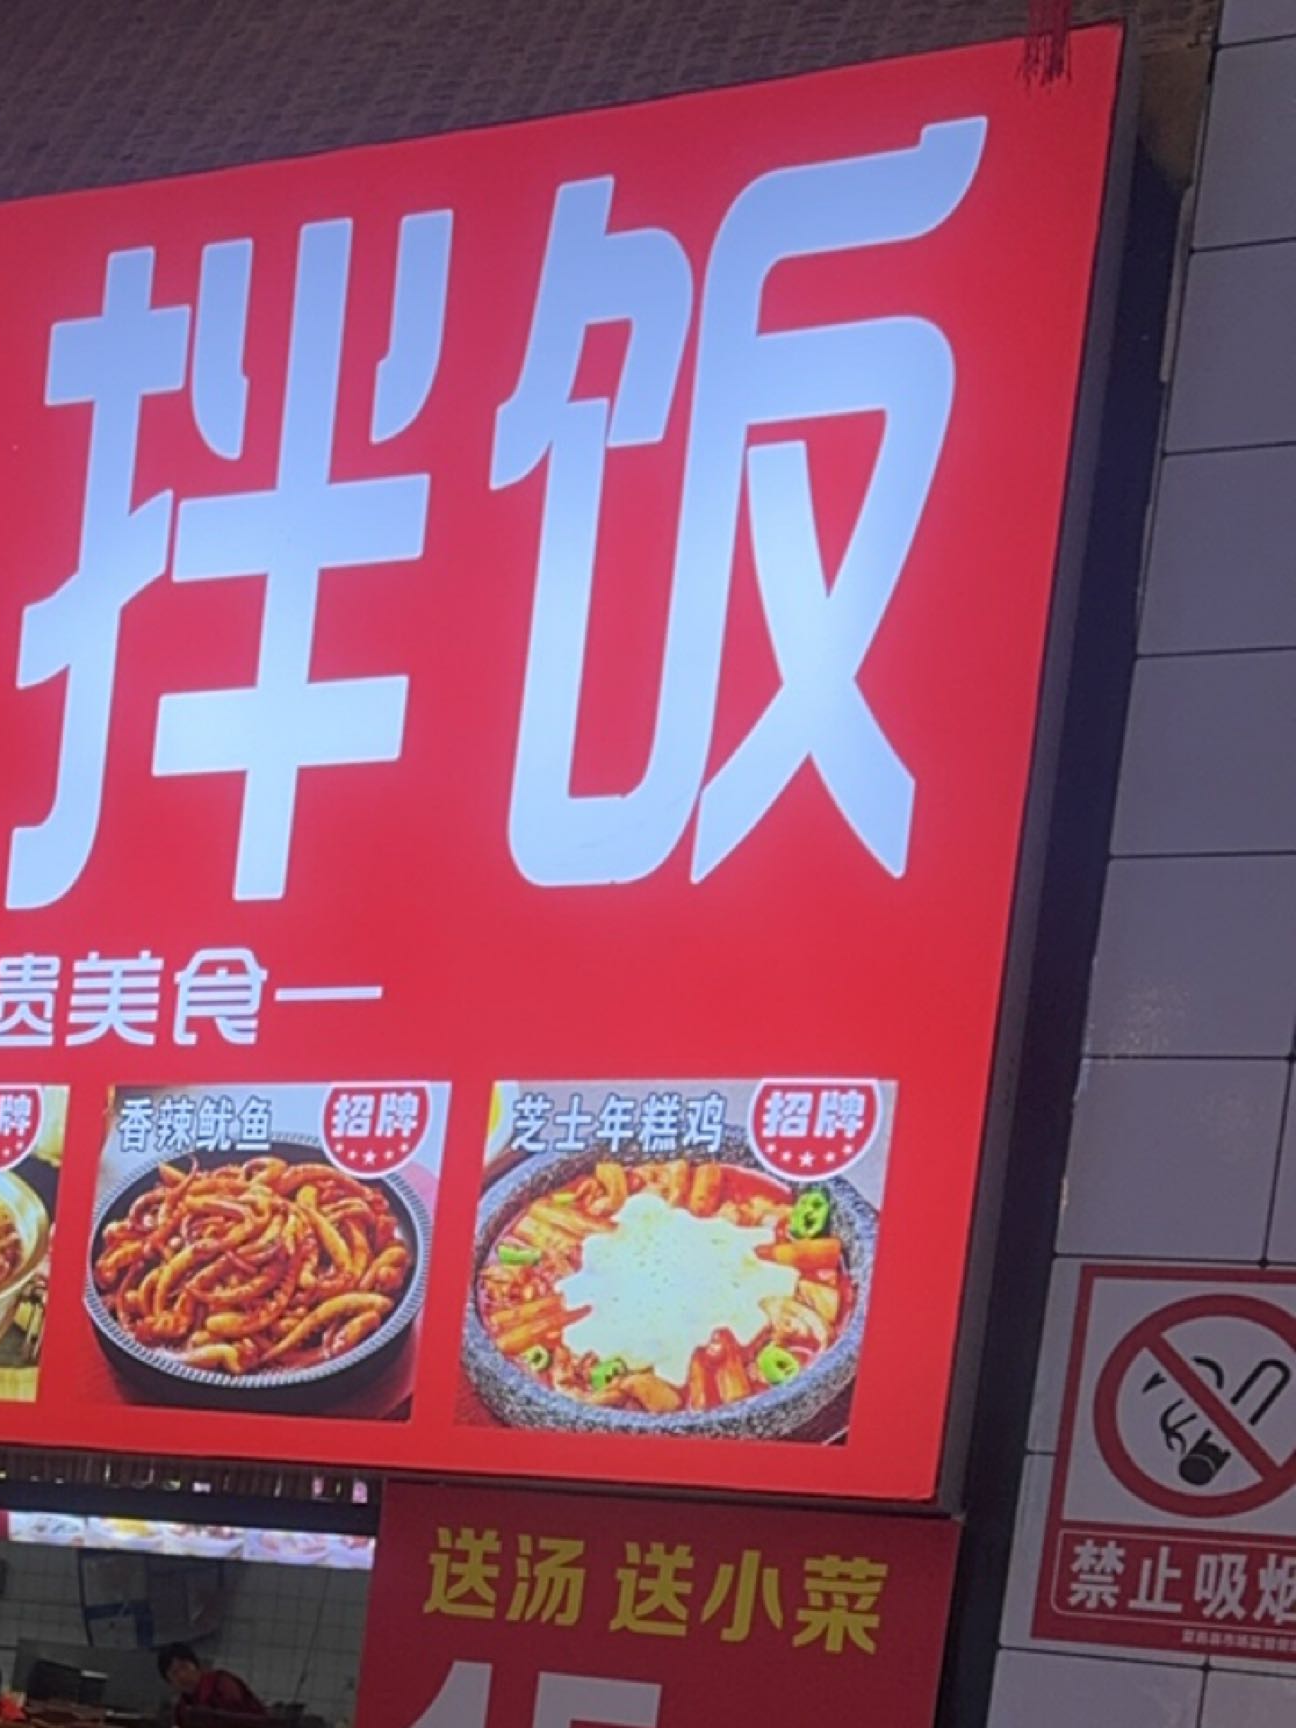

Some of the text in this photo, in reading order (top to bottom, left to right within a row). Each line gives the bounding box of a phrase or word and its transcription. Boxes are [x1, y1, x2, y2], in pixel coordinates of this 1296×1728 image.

[119, 1096, 273, 1153] 香辣鱿鱼
[331, 1094, 418, 1139] 招牌
[512, 1092, 725, 1154] 芝士年糕鸡
[761, 1090, 866, 1140] 招牌
[423, 1527, 888, 1655] 送汤 送小菜
[1068, 1539, 1296, 1625] 禁止吸烟
